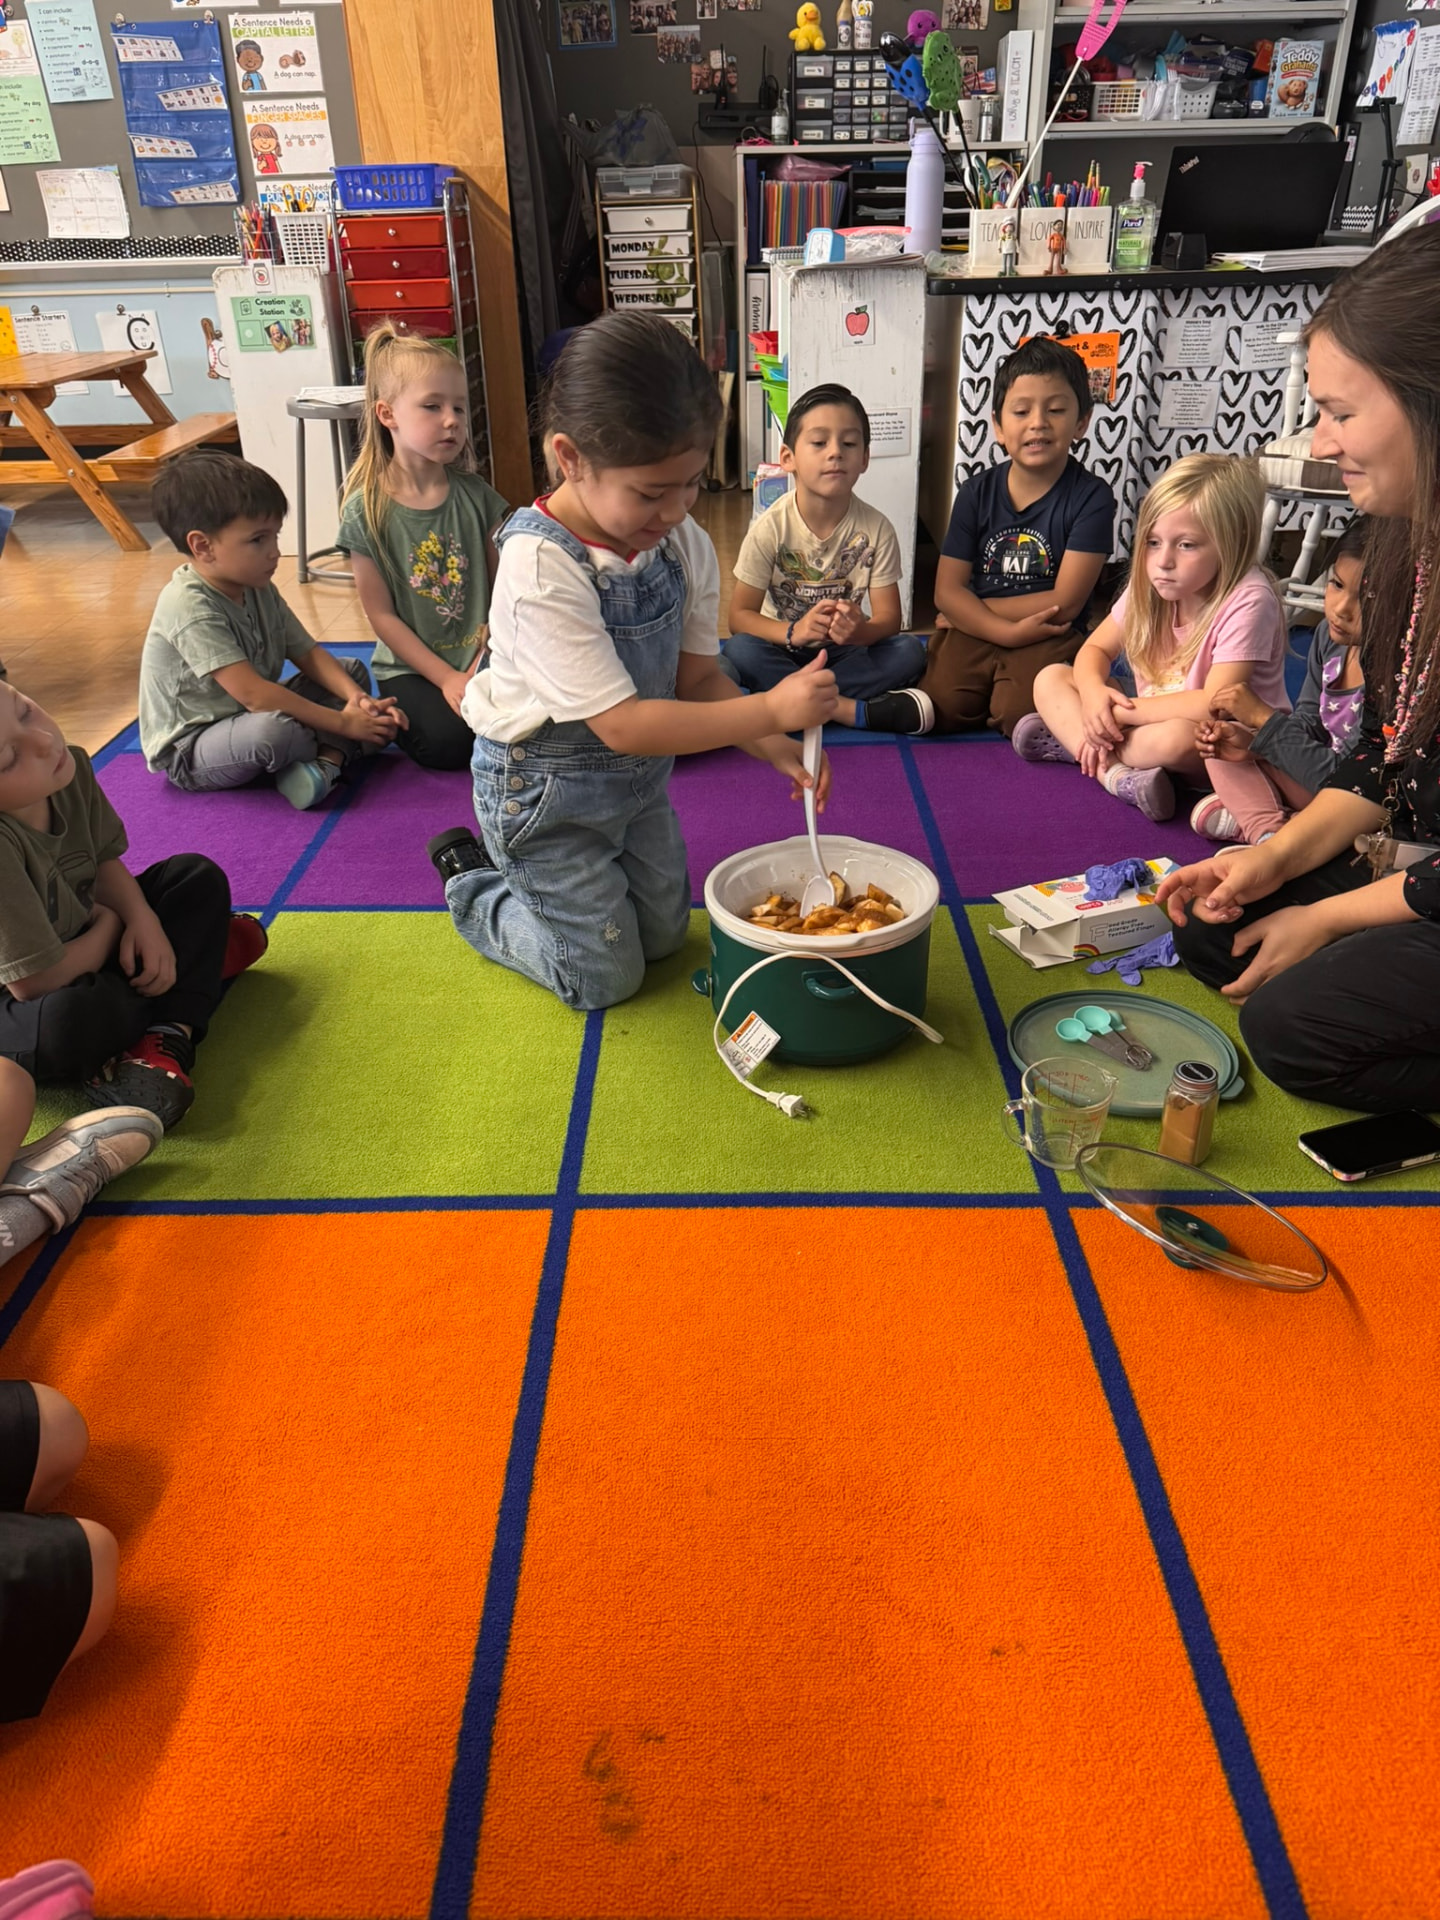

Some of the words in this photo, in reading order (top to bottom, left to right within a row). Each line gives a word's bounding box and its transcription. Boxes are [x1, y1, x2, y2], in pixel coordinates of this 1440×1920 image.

[236, 27, 278, 37] CAPITAL
[280, 27, 311, 36] LETTER
[1284, 48, 1320, 63] Teddy
[1011, 57, 1021, 85] TEACH
[252, 113, 284, 123] FINGER
[1074, 220, 1104, 240] INSPIRE
[612, 242, 655, 253] MONDAY
[610, 269, 656, 279] TUESDAY
[615, 294, 676, 303] WEDNESDAY
[795, 586, 846, 597] MONSTER
[1108, 929, 1135, 937] Textured
